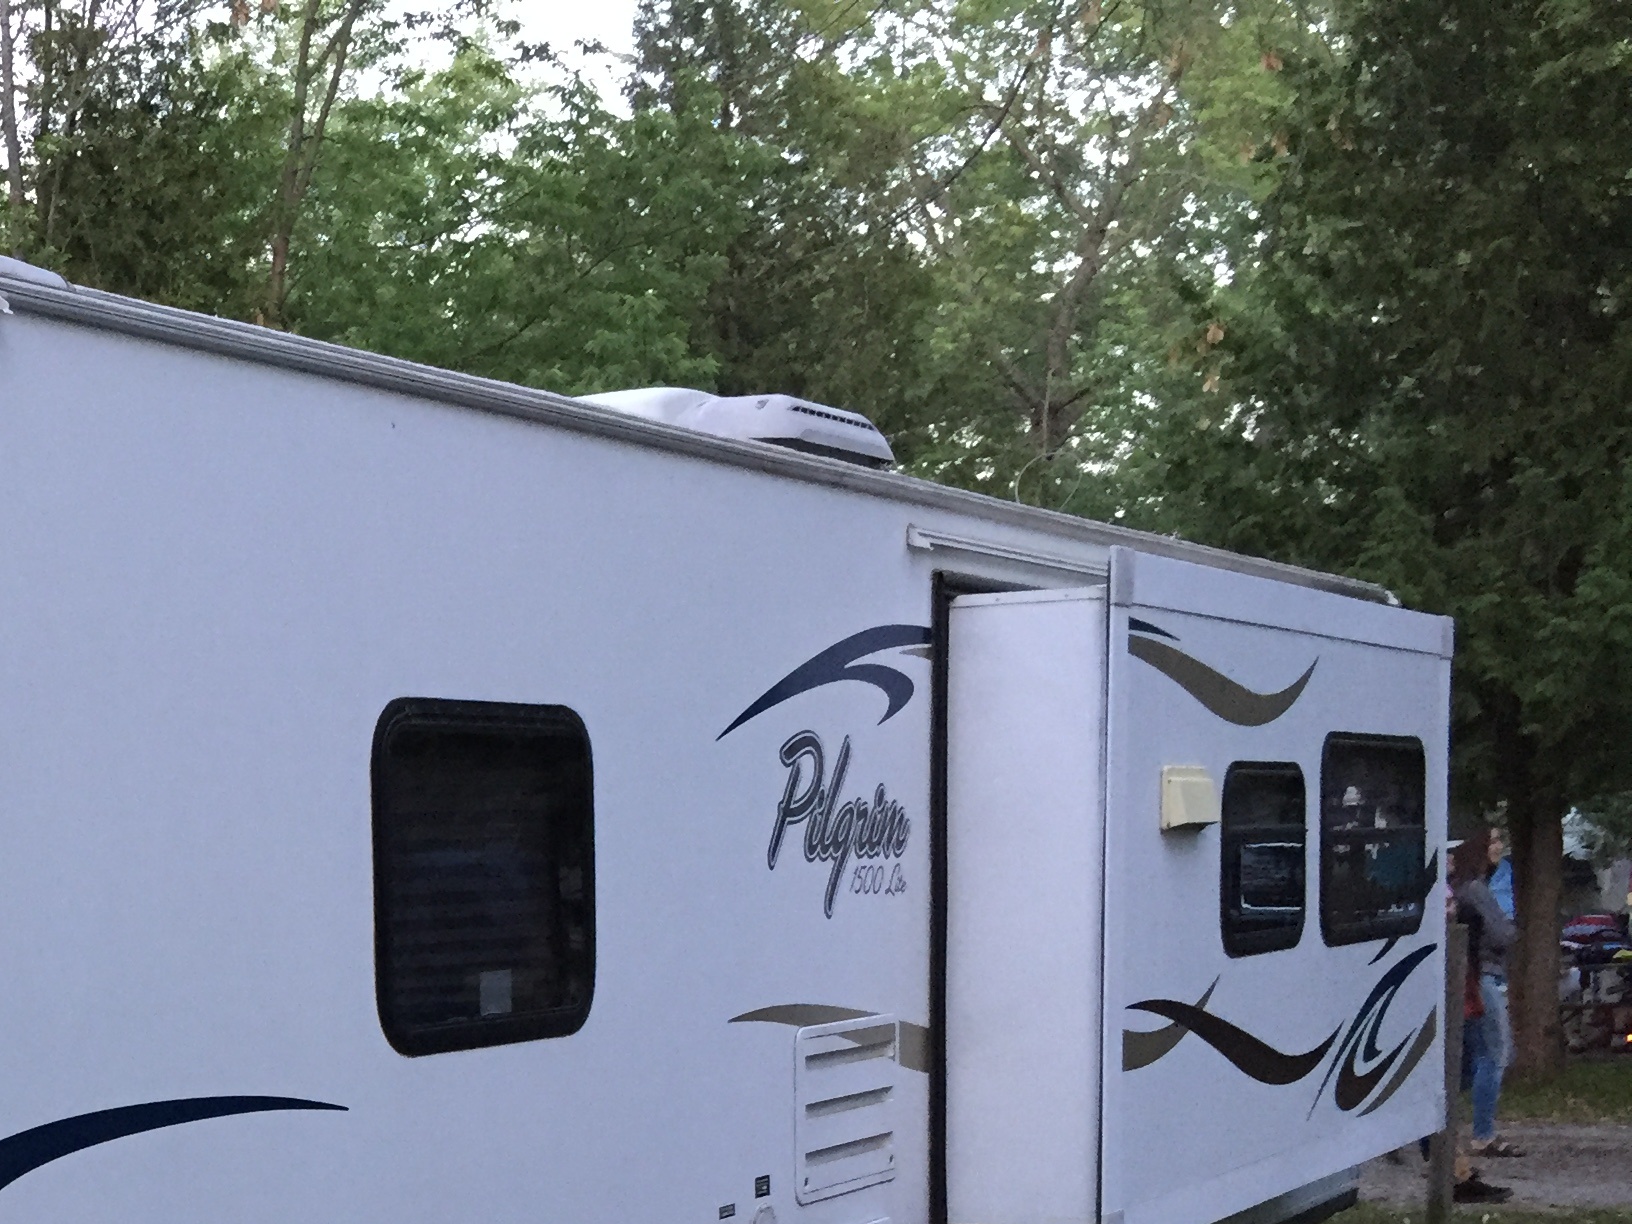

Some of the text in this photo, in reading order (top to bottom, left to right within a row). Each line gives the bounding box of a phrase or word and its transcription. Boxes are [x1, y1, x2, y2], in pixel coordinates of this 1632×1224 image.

[768, 730, 910, 919] Pilgrim
[850, 862, 907, 896] 1500 Lite
